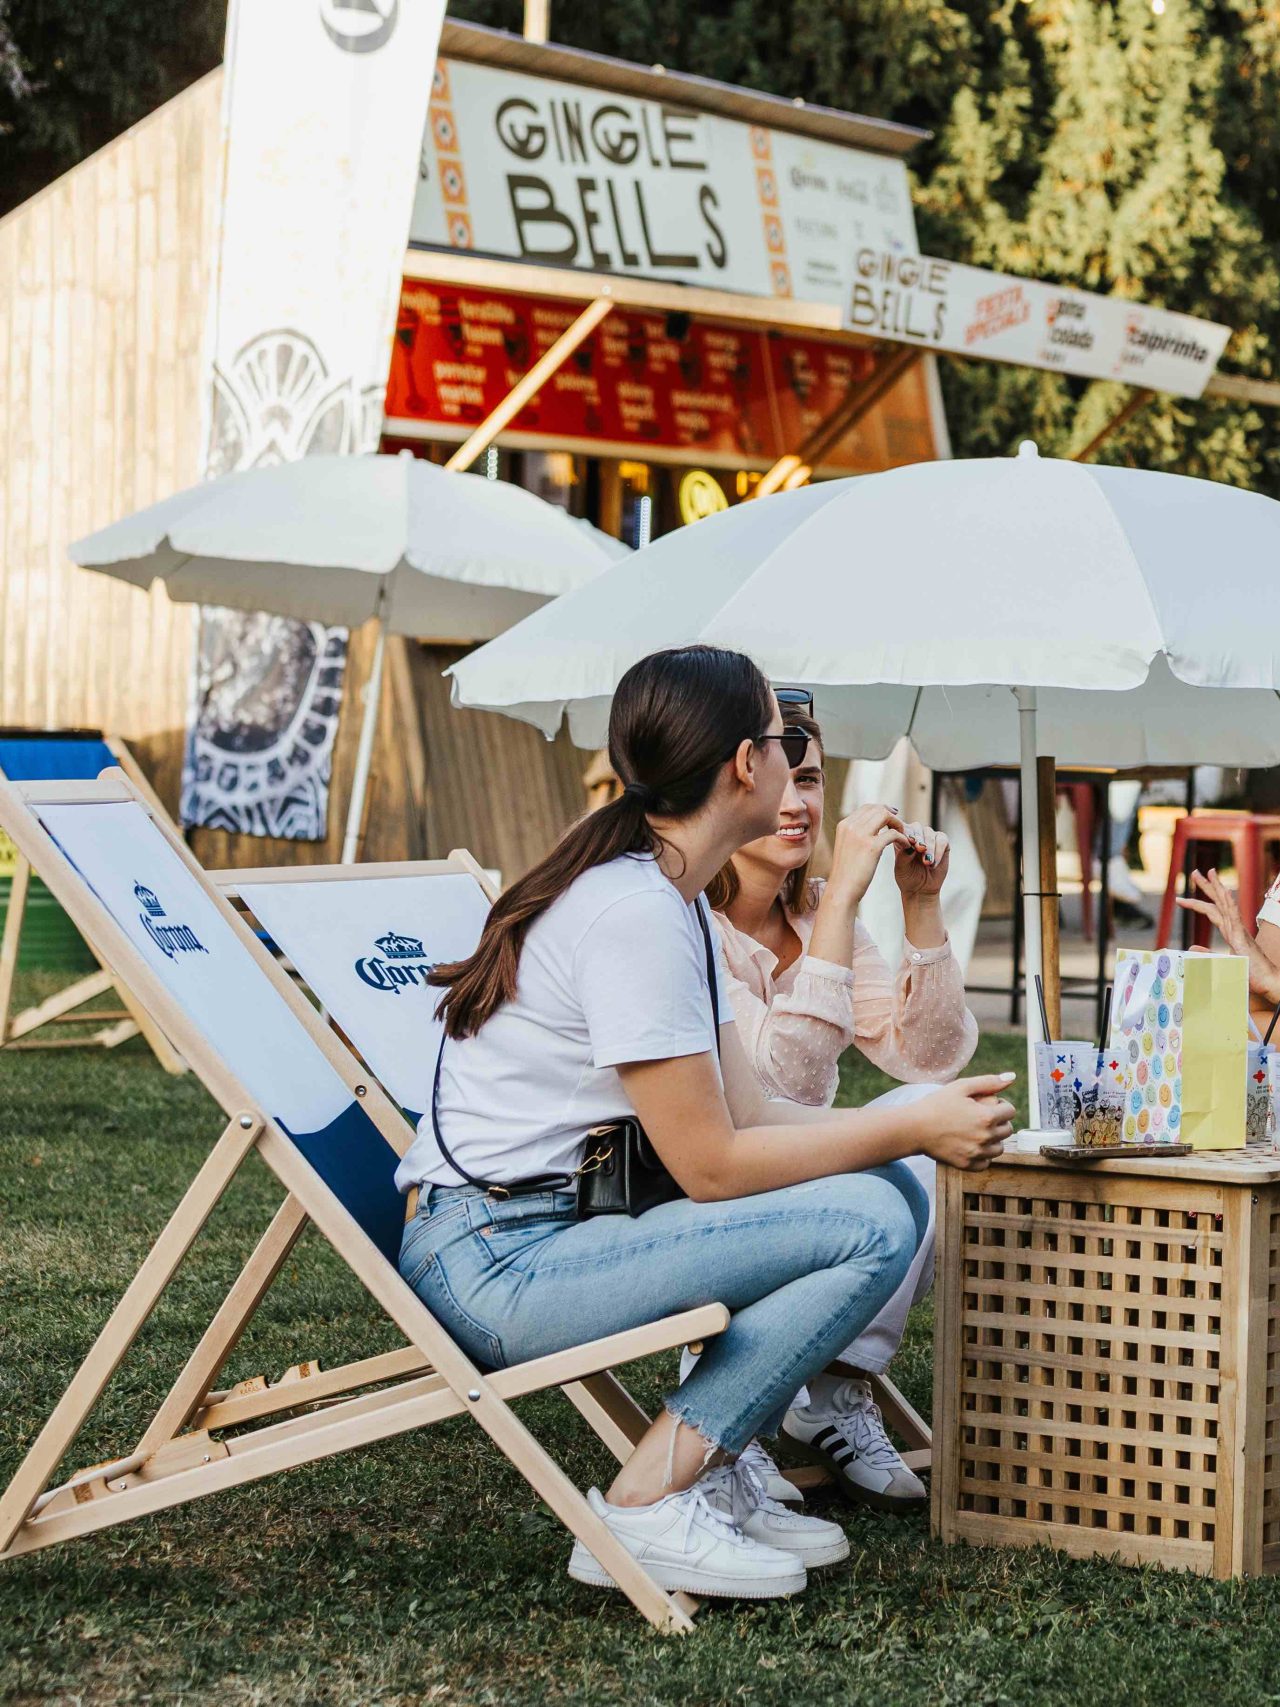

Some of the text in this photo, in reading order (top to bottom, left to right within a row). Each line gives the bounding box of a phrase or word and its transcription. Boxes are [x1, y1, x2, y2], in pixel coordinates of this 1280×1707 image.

[494, 98, 707, 170] GINGLE
[506, 174, 727, 270] BELLS
[856, 248, 950, 295] GINGLE
[851, 282, 947, 340] BELLS
[139, 913, 209, 964] Corona
[355, 957, 430, 995] Cor
